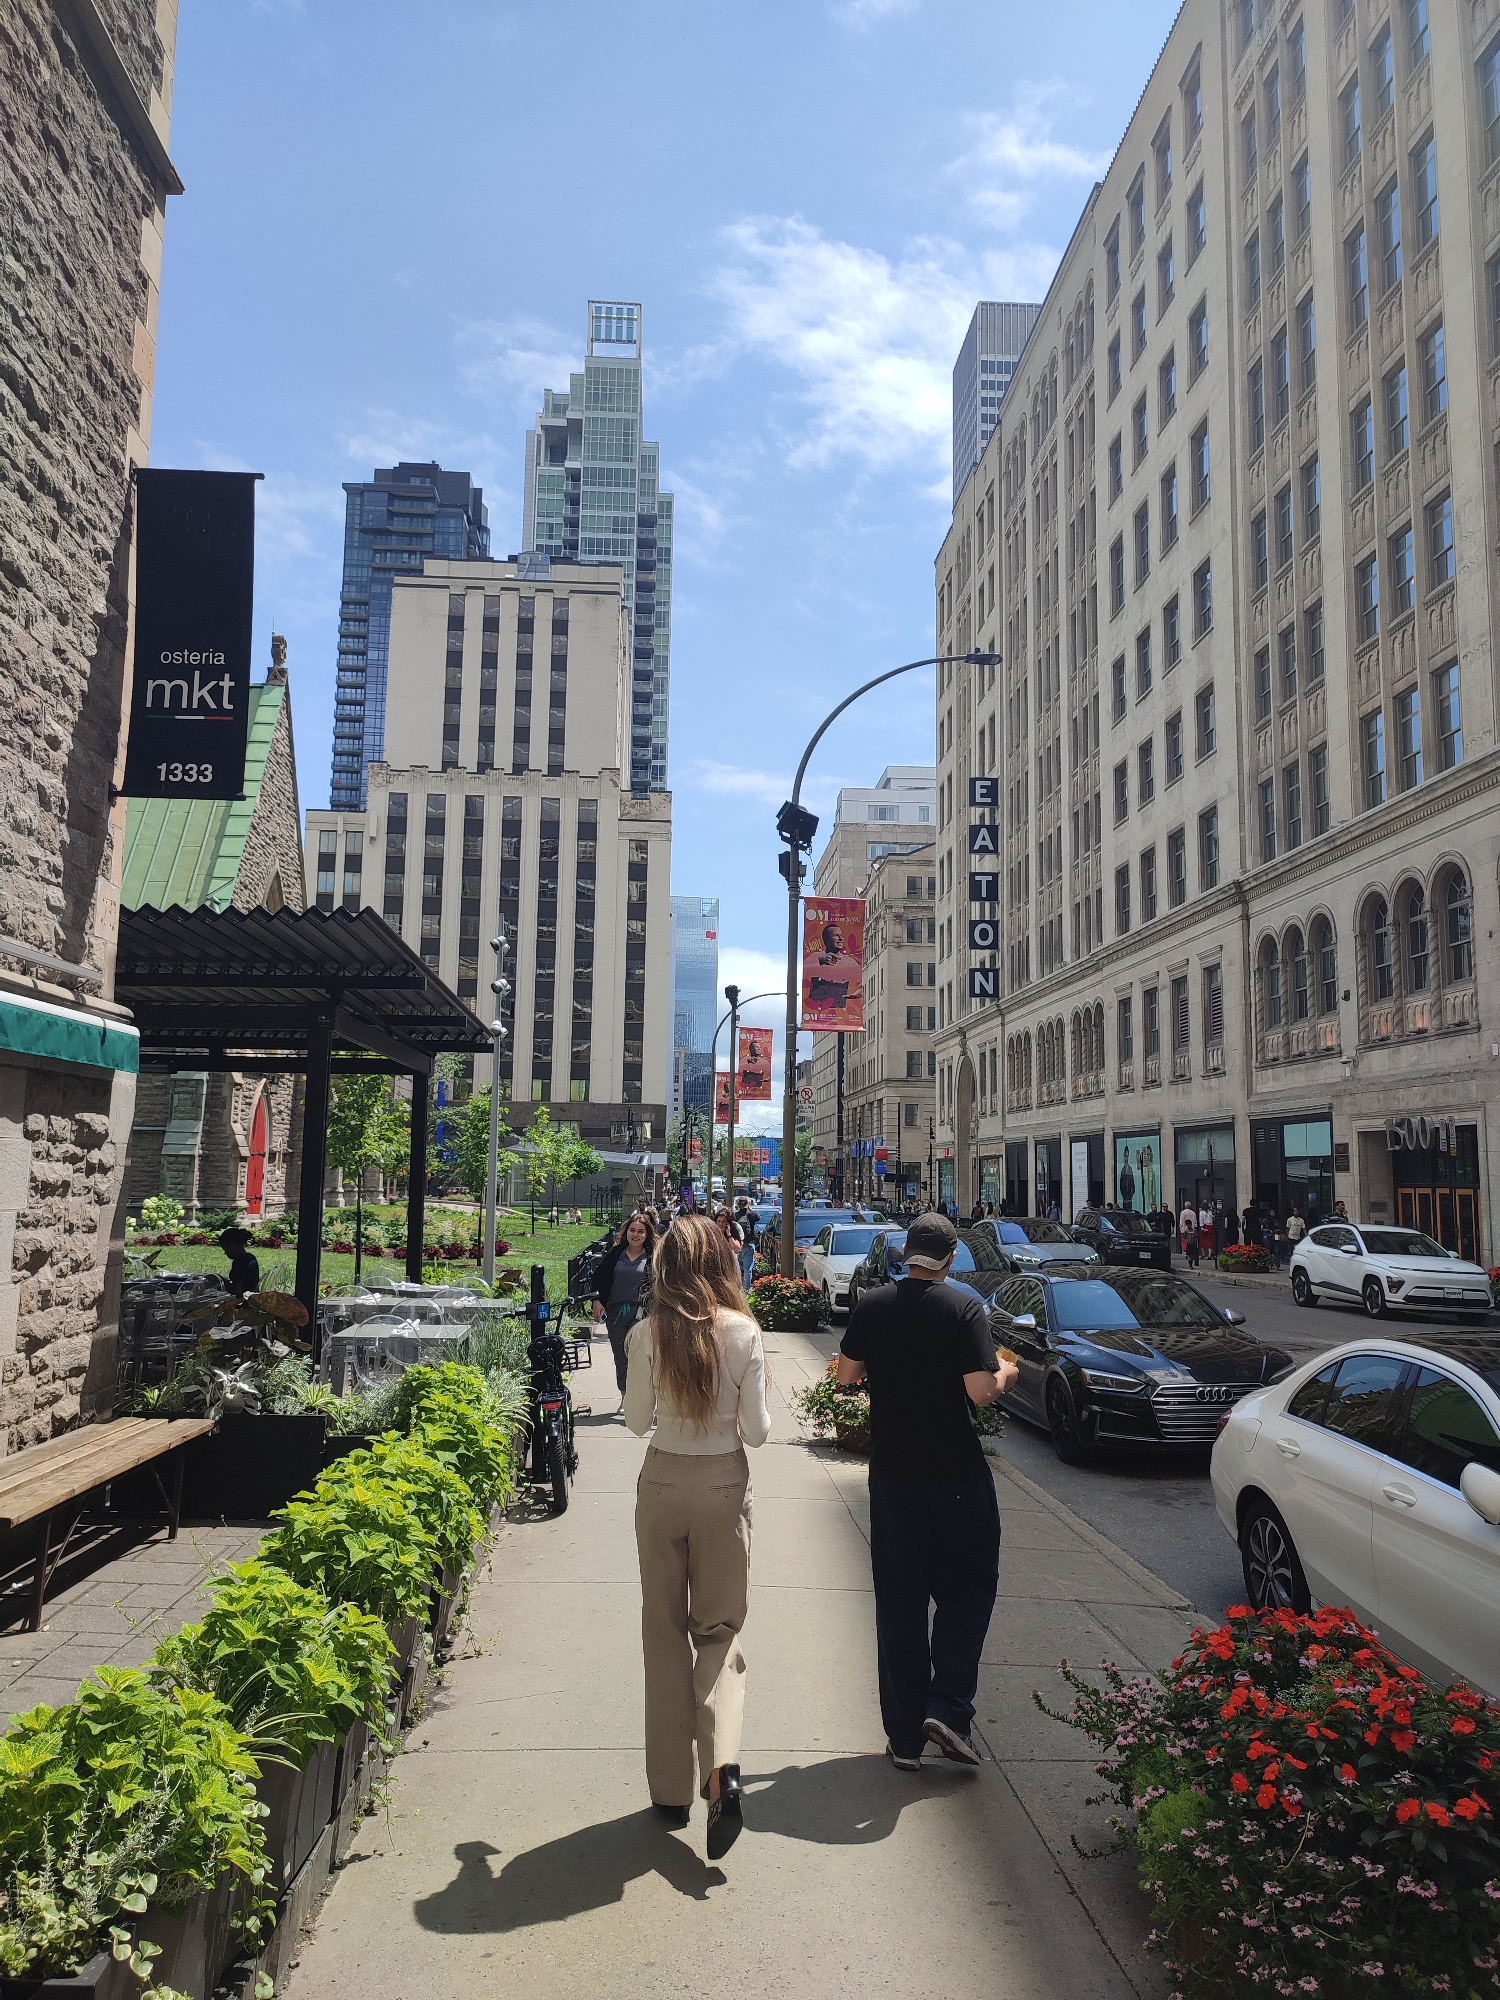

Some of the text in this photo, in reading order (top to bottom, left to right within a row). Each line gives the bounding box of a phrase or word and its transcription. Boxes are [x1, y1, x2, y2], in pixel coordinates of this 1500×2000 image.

[160, 648, 226, 665] osteria
[145, 670, 236, 710] mkt
[156, 762, 213, 783] 1333
[972, 780, 995, 995] EATON
